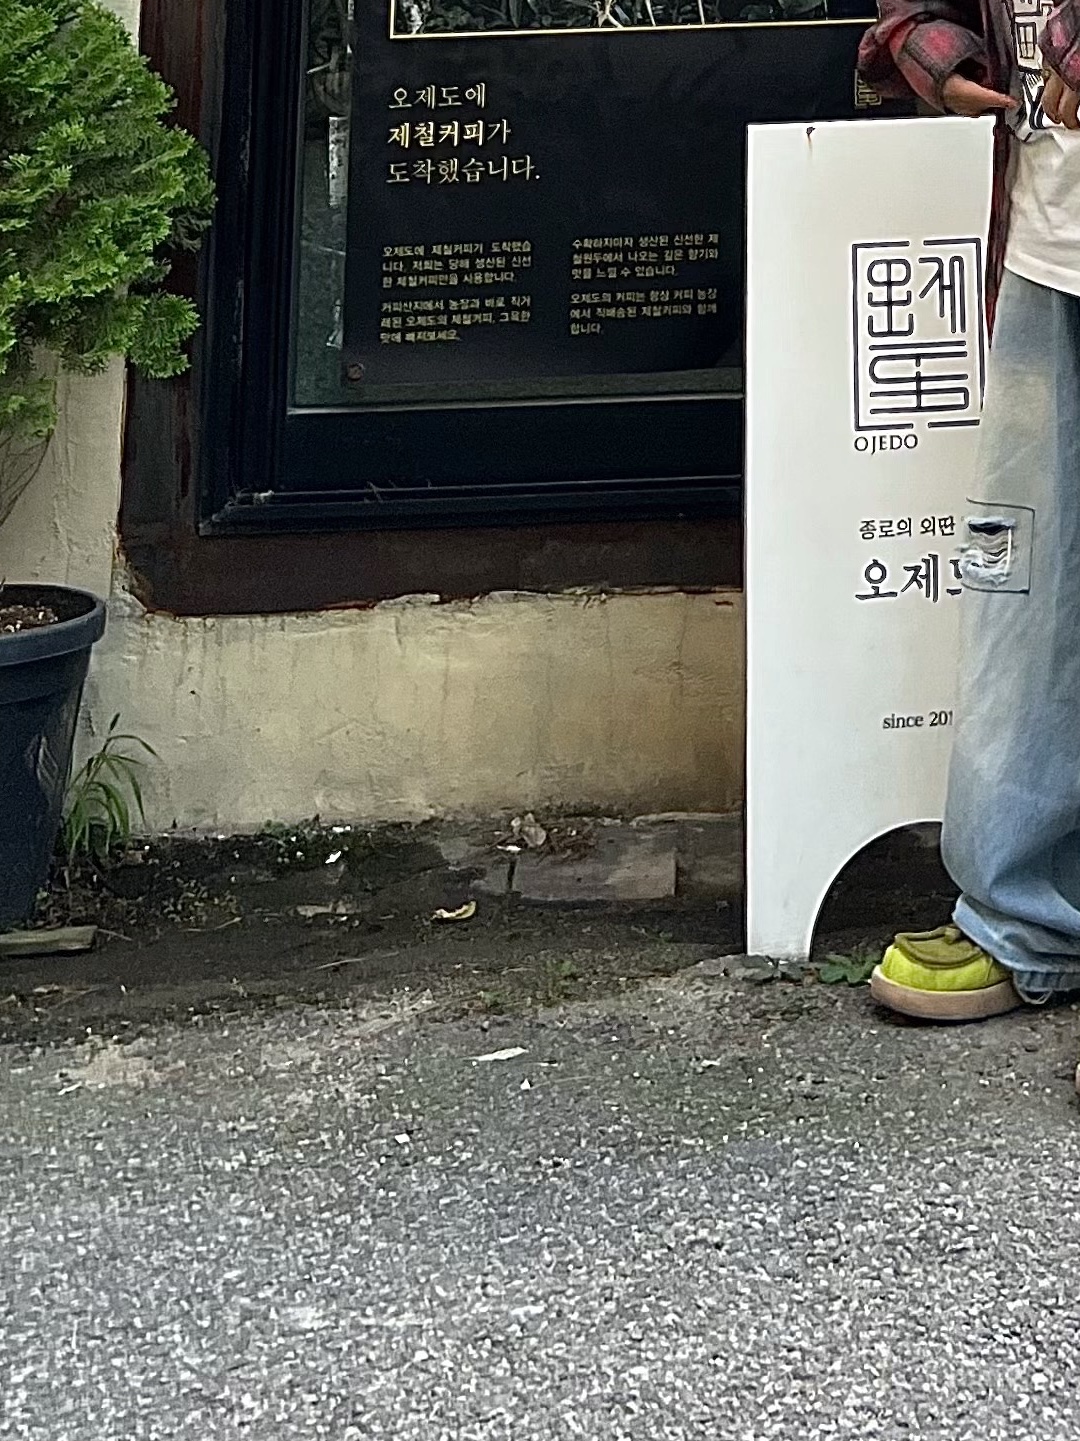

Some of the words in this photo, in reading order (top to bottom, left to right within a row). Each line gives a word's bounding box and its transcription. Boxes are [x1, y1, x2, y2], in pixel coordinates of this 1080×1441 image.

[388, 82, 486, 110] 오제도에
[387, 118, 511, 149] 제철커피가
[386, 155, 541, 185] 도착했습니다.
[673, 234, 704, 246] 신선한
[511, 255, 531, 268] 신선
[627, 250, 659, 262] 나오는
[620, 267, 631, 277] 수
[853, 433, 919, 456] OJEDO
[858, 516, 912, 541] 종로의
[919, 515, 956, 537] 외딴
[882, 712, 924, 729] since
